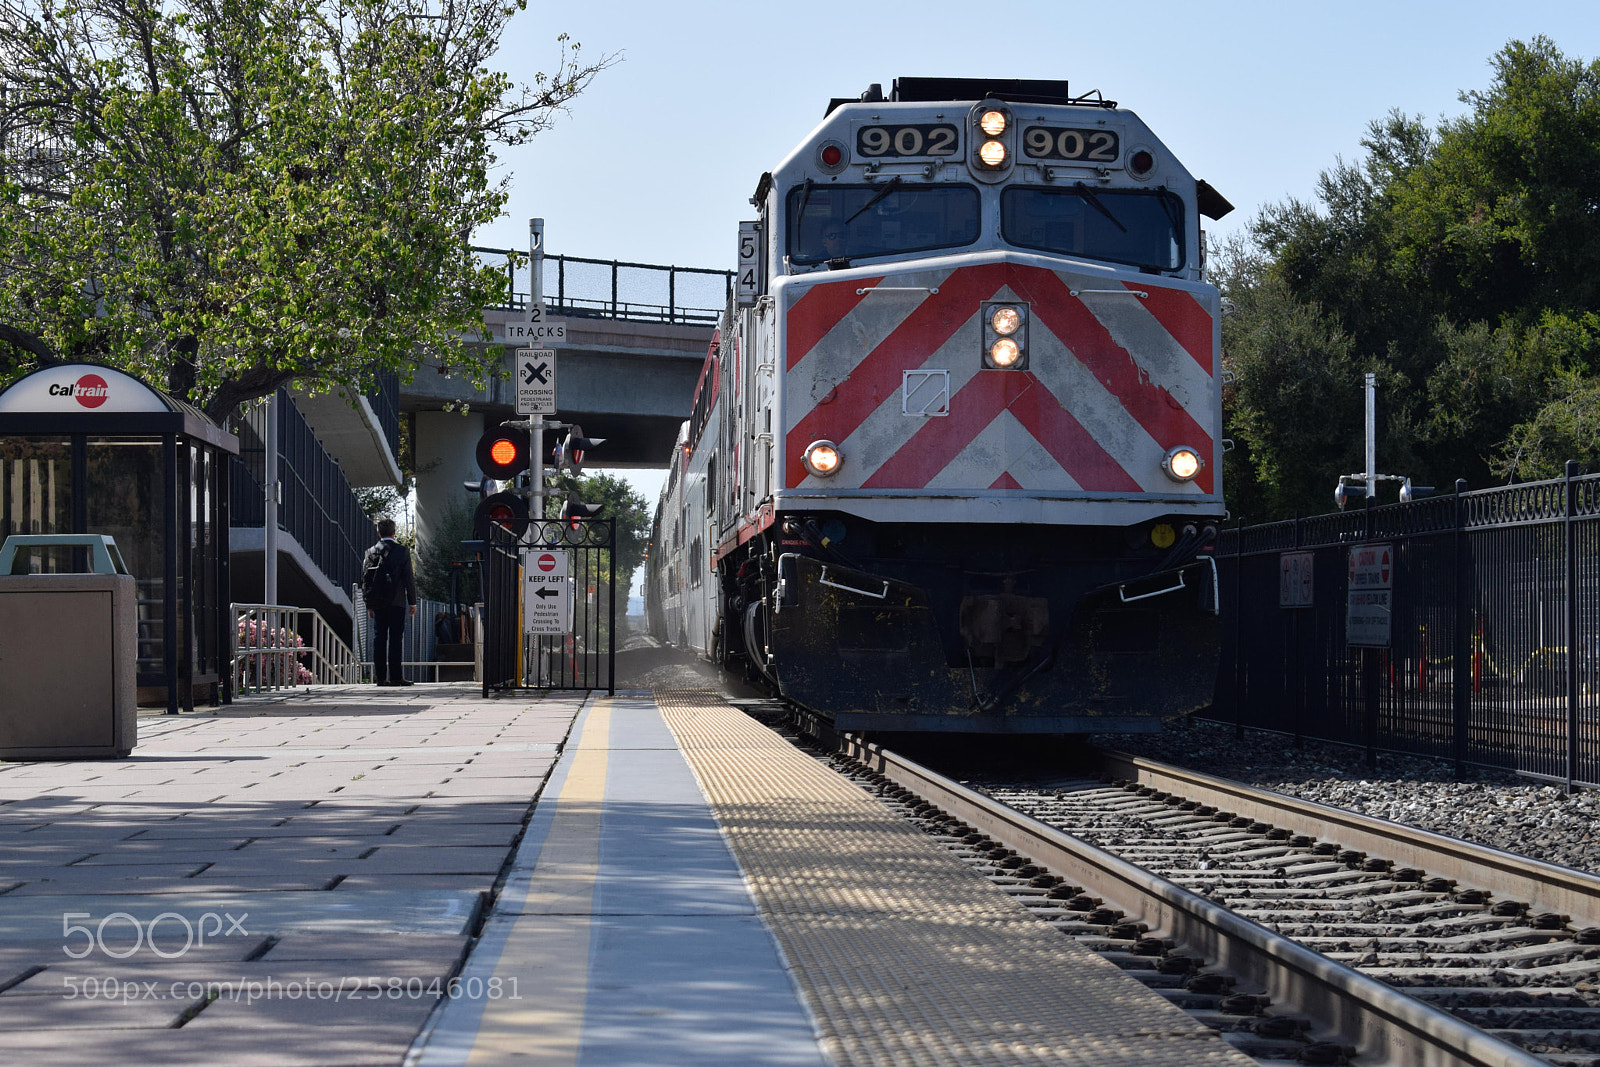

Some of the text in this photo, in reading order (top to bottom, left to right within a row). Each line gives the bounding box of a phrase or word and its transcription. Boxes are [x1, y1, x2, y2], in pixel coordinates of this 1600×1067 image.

[862, 127, 956, 155] 902
[1026, 128, 1115, 160] 902
[740, 237, 755, 259] 5
[741, 268, 756, 290] 4
[531, 308, 541, 323] 2
[508, 327, 564, 337] TRACKS
[48, 383, 110, 397] Caltrain
